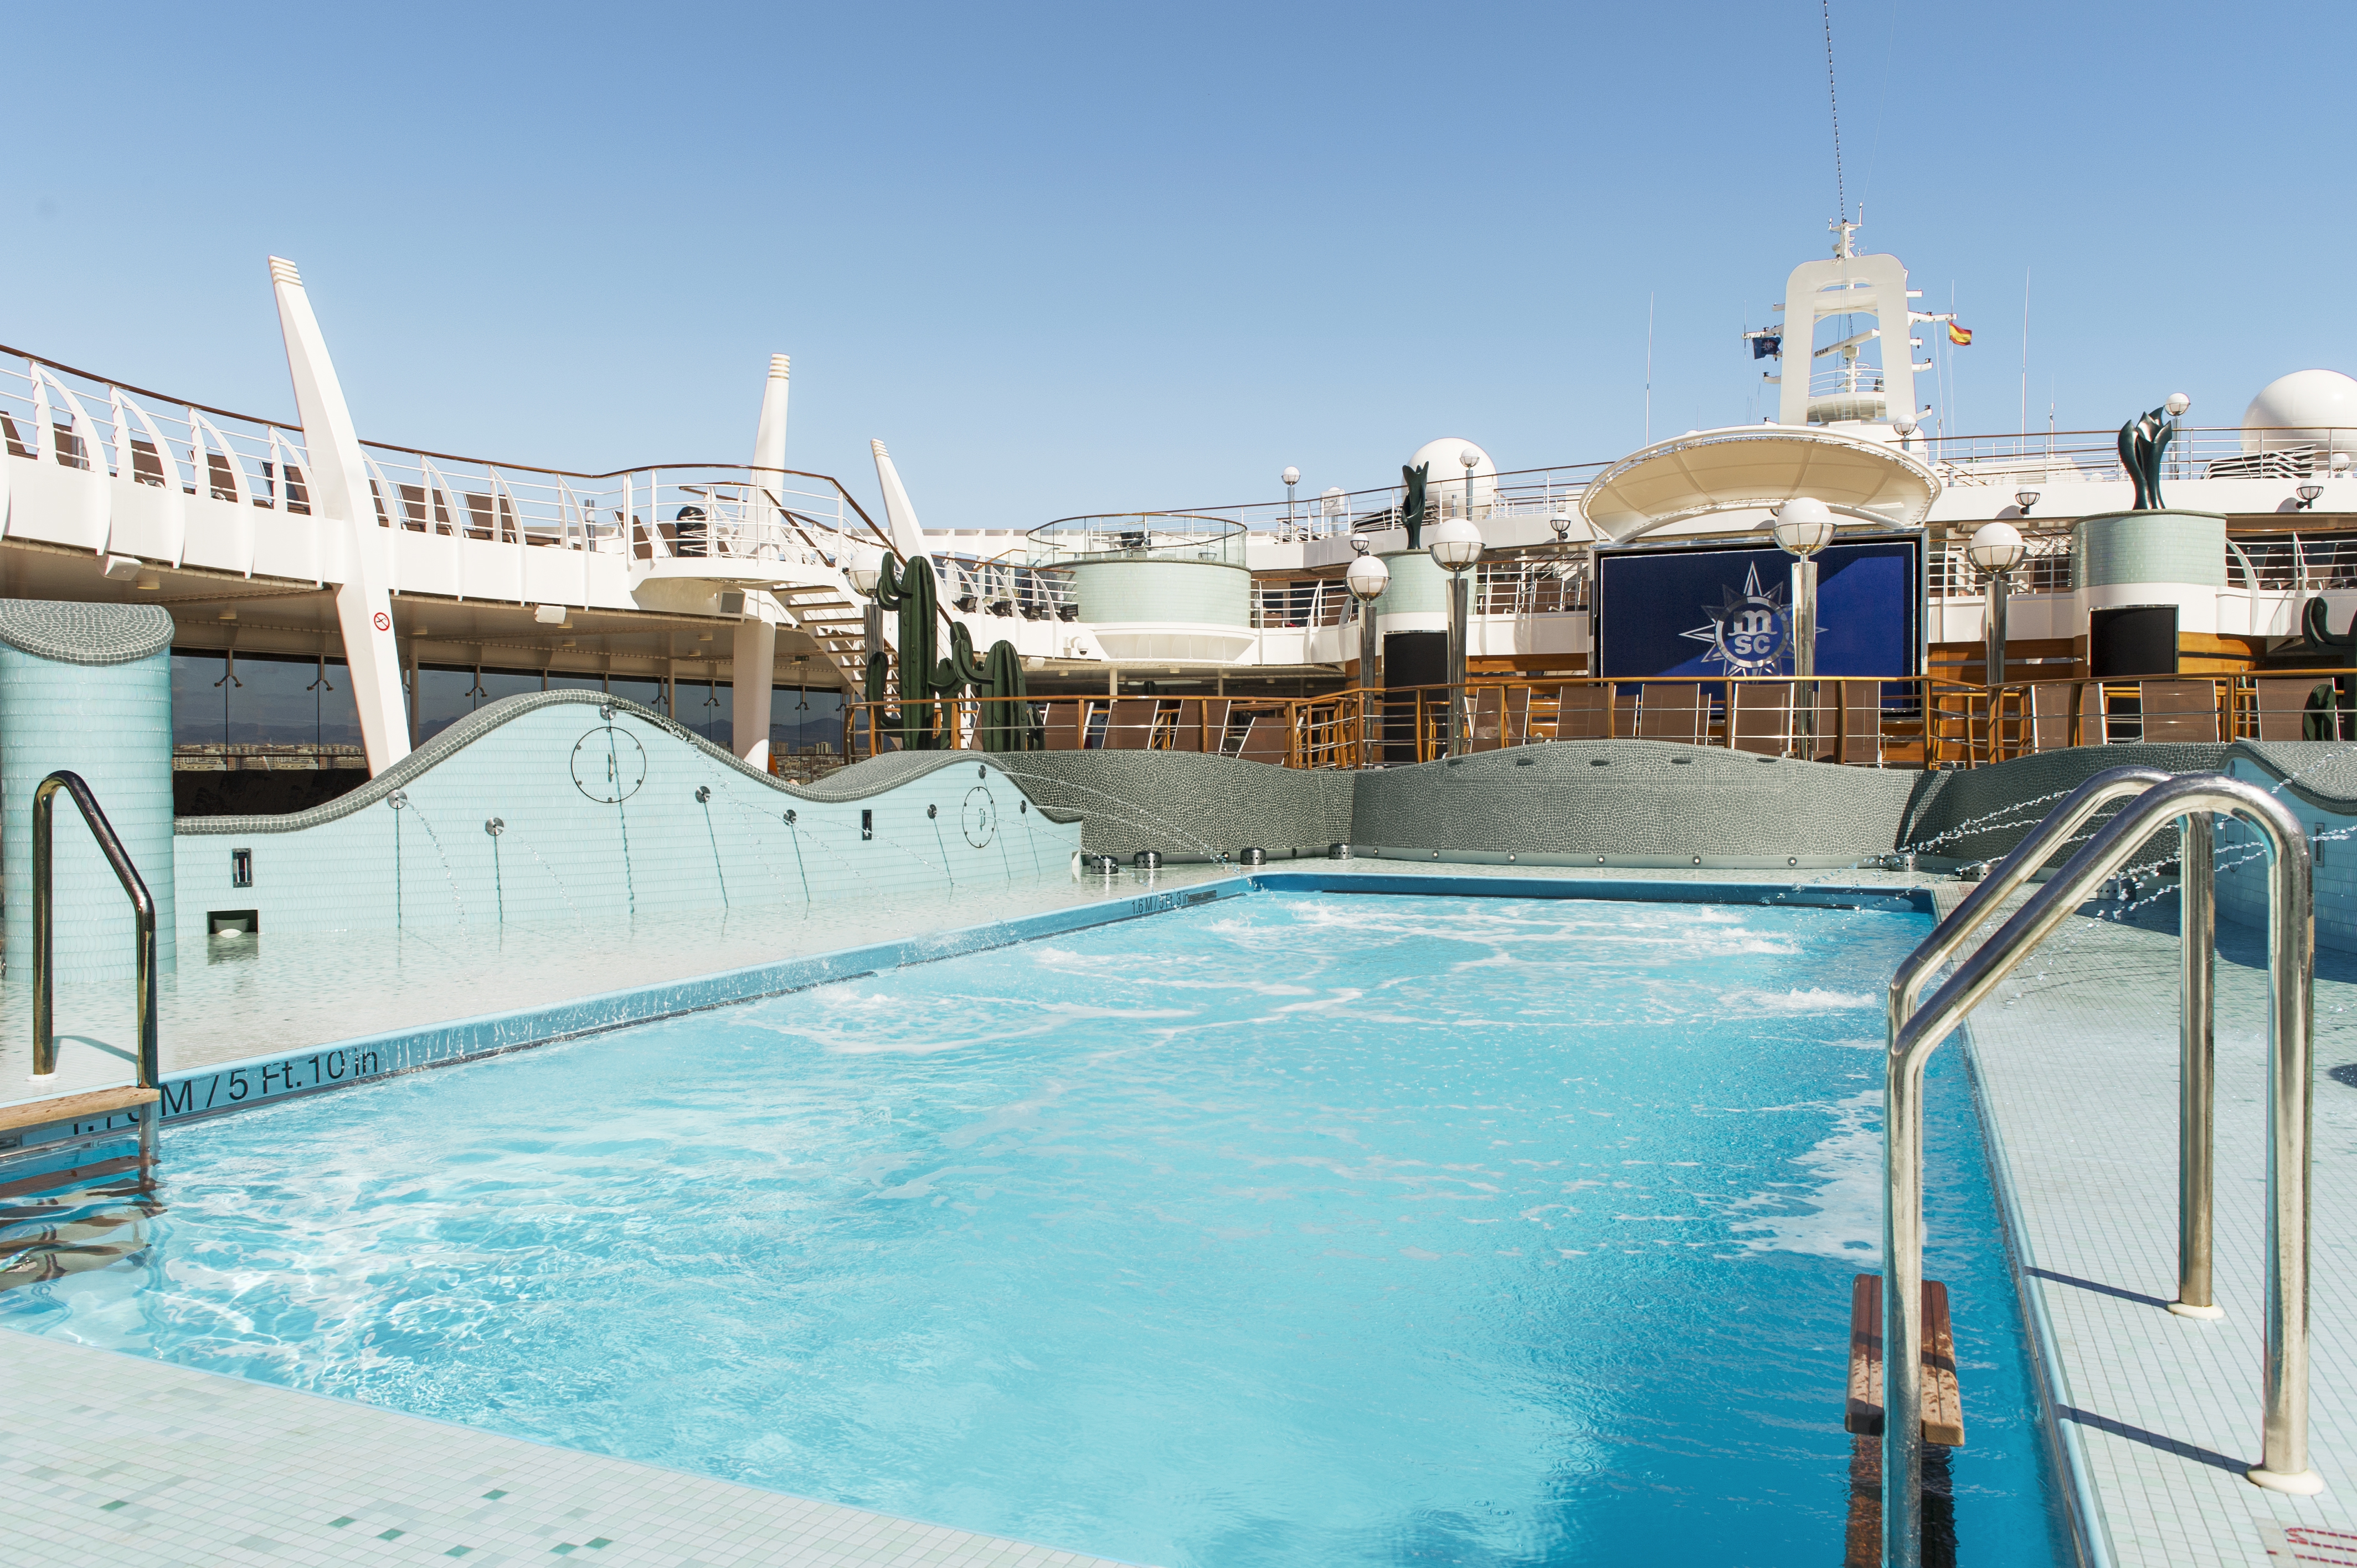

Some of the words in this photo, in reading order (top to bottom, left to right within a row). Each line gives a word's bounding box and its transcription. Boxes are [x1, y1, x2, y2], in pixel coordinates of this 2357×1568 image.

[1131, 899, 1144, 914] 1.6
[1145, 897, 1152, 912] M
[1176, 892, 1181, 905] 3
[1183, 891, 1189, 905] in
[160, 1080, 193, 1117] M
[229, 1069, 249, 1100] 5
[263, 1061, 302, 1094] Ft.
[308, 1050, 345, 1084] 10
[354, 1047, 378, 1078] in
